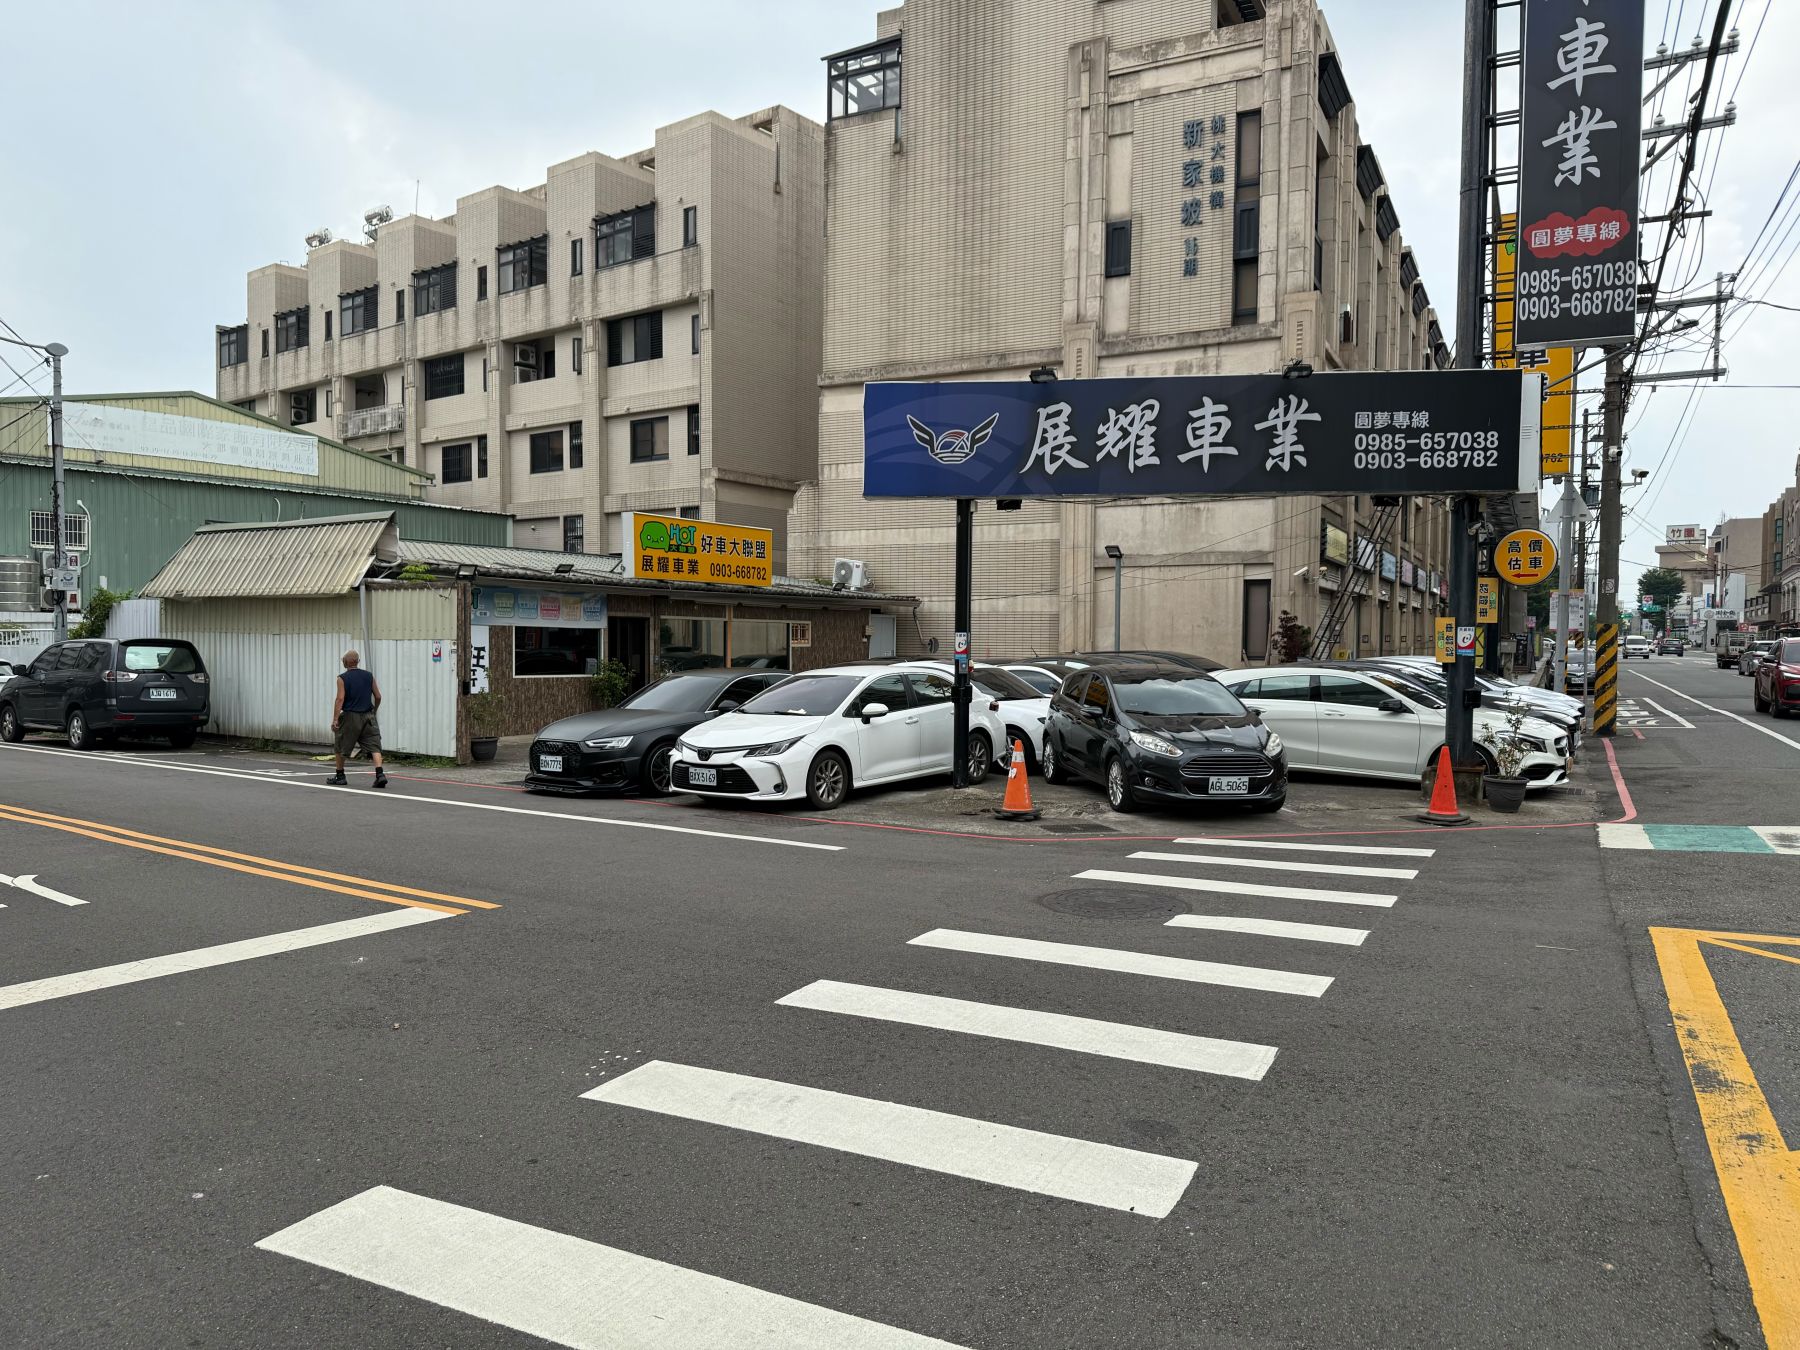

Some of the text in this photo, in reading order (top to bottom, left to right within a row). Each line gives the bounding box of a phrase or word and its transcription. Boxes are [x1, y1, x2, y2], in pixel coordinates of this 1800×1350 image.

[1542, 0, 1618, 187] 車業
[1531, 221, 1621, 249] 圓夢專線
[1519, 260, 1635, 295] 0985-657038
[1519, 287, 1635, 321] 0903-668782
[1354, 411, 1430, 429] 圓夢專線
[1019, 394, 1322, 474] 展耀車業
[1354, 431, 1499, 451] 0985-657038
[1354, 450, 1498, 469] 0903-668782
[670, 523, 697, 545] HOT
[701, 534, 766, 559] 好車大聯盟
[1507, 539, 1543, 554] 高價
[642, 554, 699, 575] 展耀車業
[710, 562, 767, 581] 0903-668782
[1507, 556, 1543, 571] 估車
[1210, 781, 1248, 791] AGL-5065
